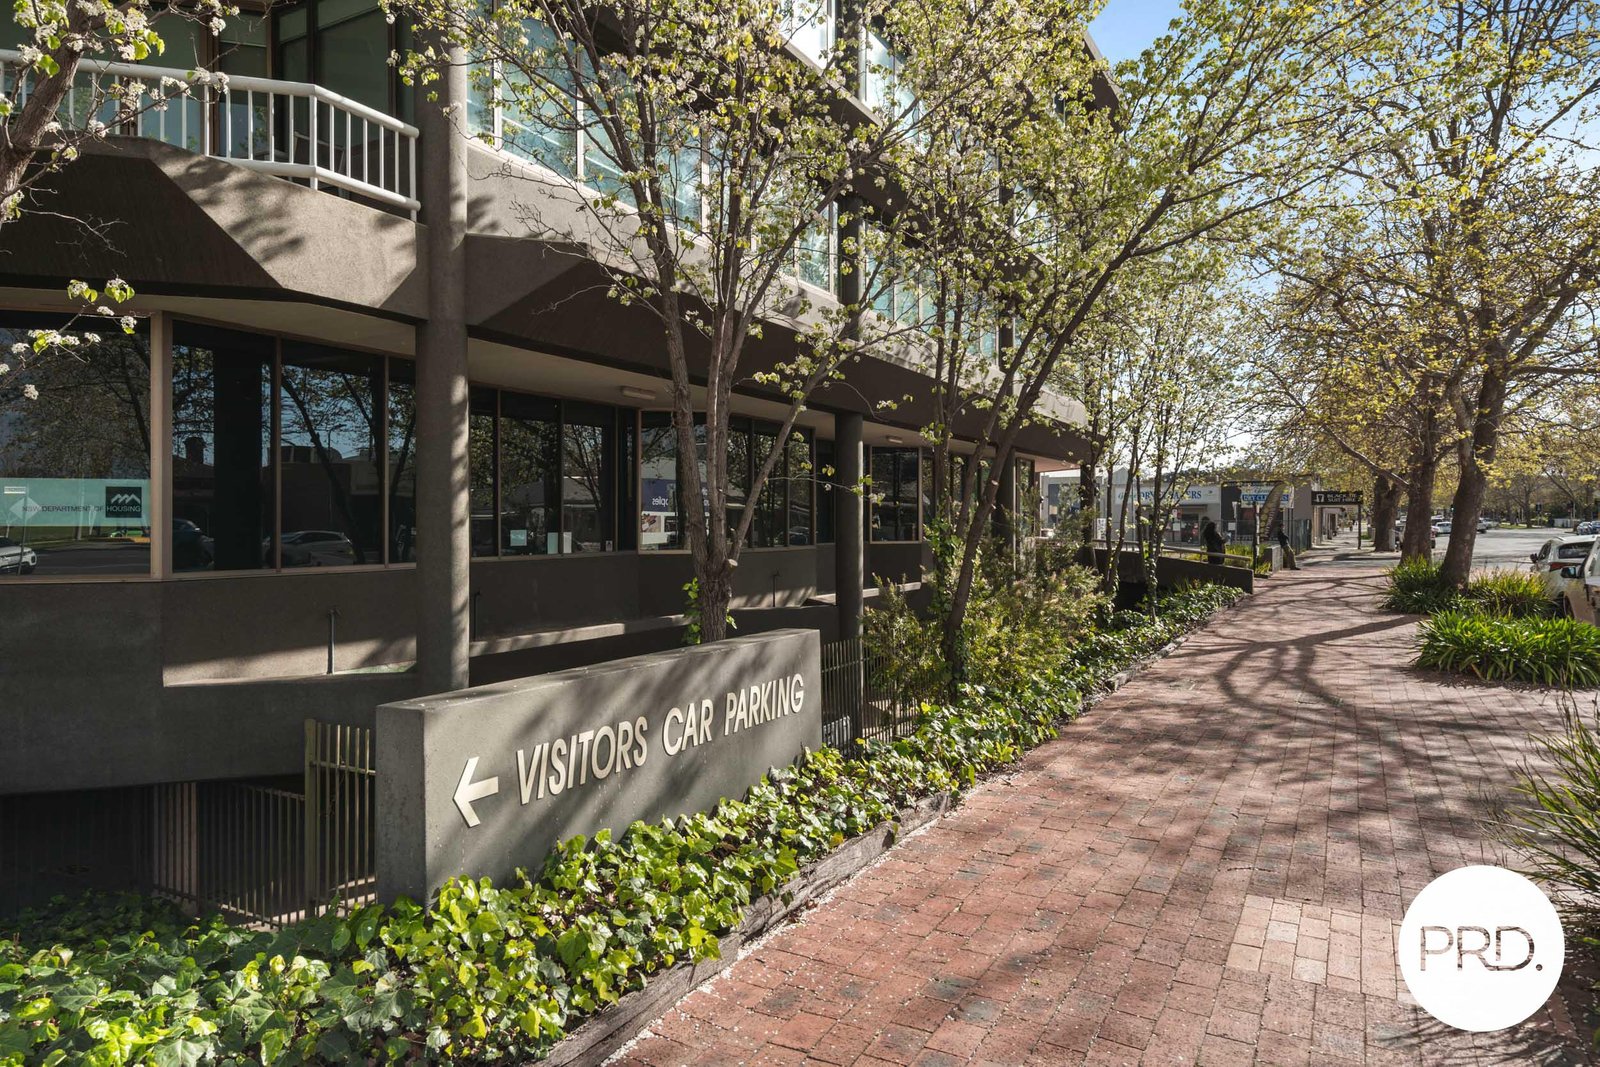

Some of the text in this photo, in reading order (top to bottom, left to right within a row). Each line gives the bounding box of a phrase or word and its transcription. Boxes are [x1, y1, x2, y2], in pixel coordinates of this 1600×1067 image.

[106, 505, 141, 513] HOUSING
[516, 673, 805, 806] VISITORS CAR PARKING
